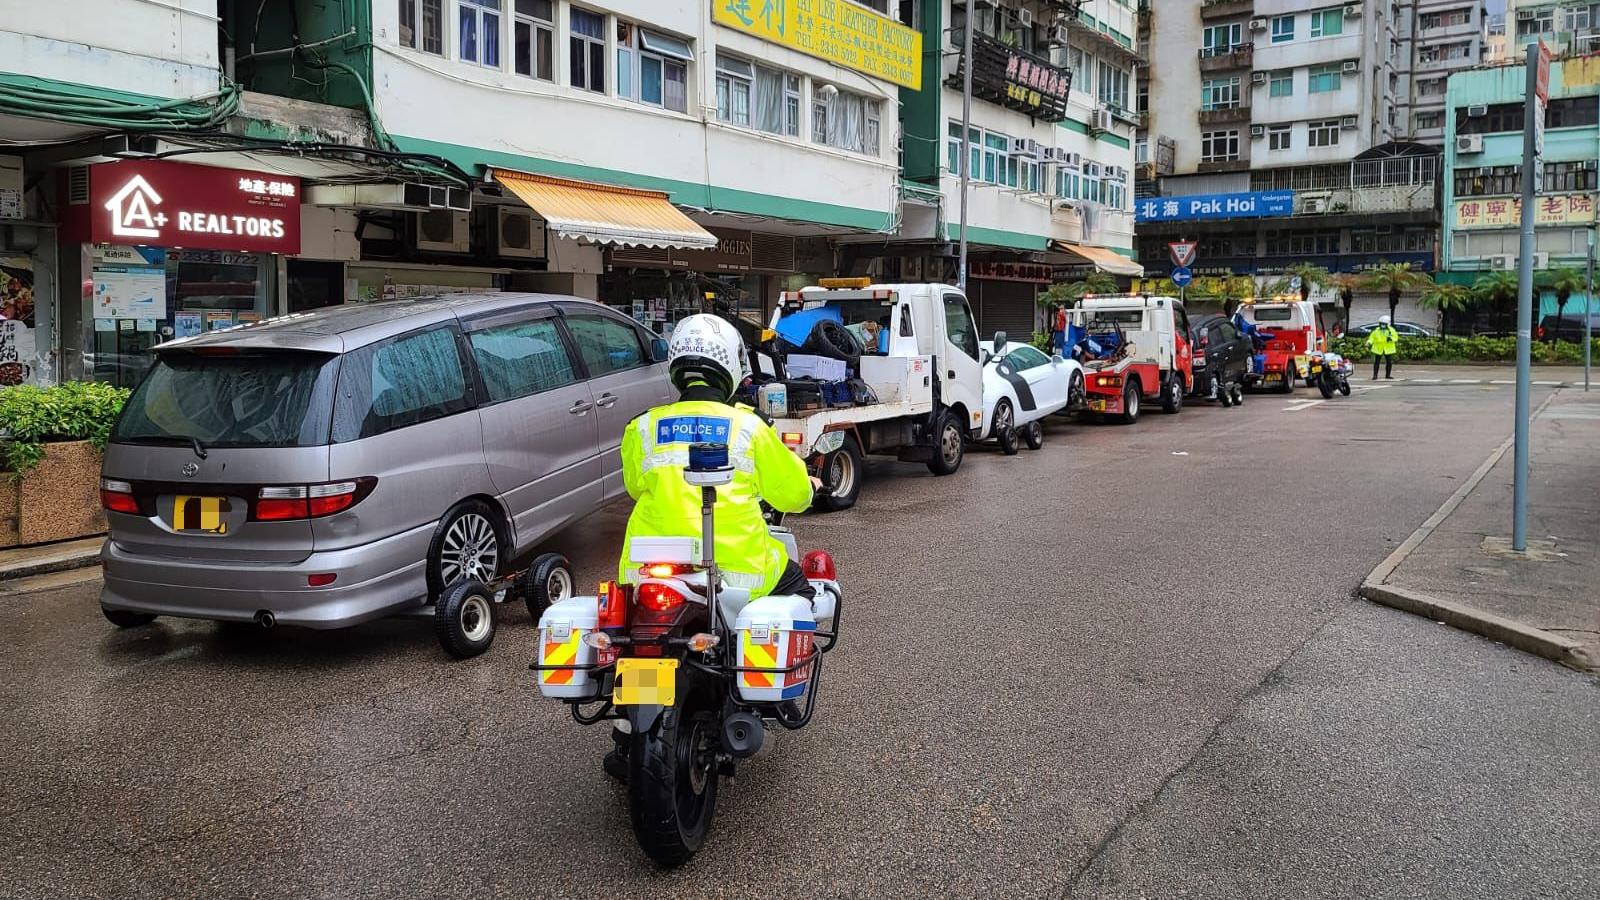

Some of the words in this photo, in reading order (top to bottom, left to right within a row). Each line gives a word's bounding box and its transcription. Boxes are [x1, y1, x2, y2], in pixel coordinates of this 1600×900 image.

[840, 6, 878, 39] LEATHER
[882, 23, 914, 53] FACTORY
[1142, 201, 1179, 218] 北海
[1191, 199, 1222, 215] Pak
[1227, 197, 1256, 213] Hoi
[179, 212, 285, 239] REALTORS
[681, 345, 705, 353] POLICE
[672, 424, 712, 435] POLICE
